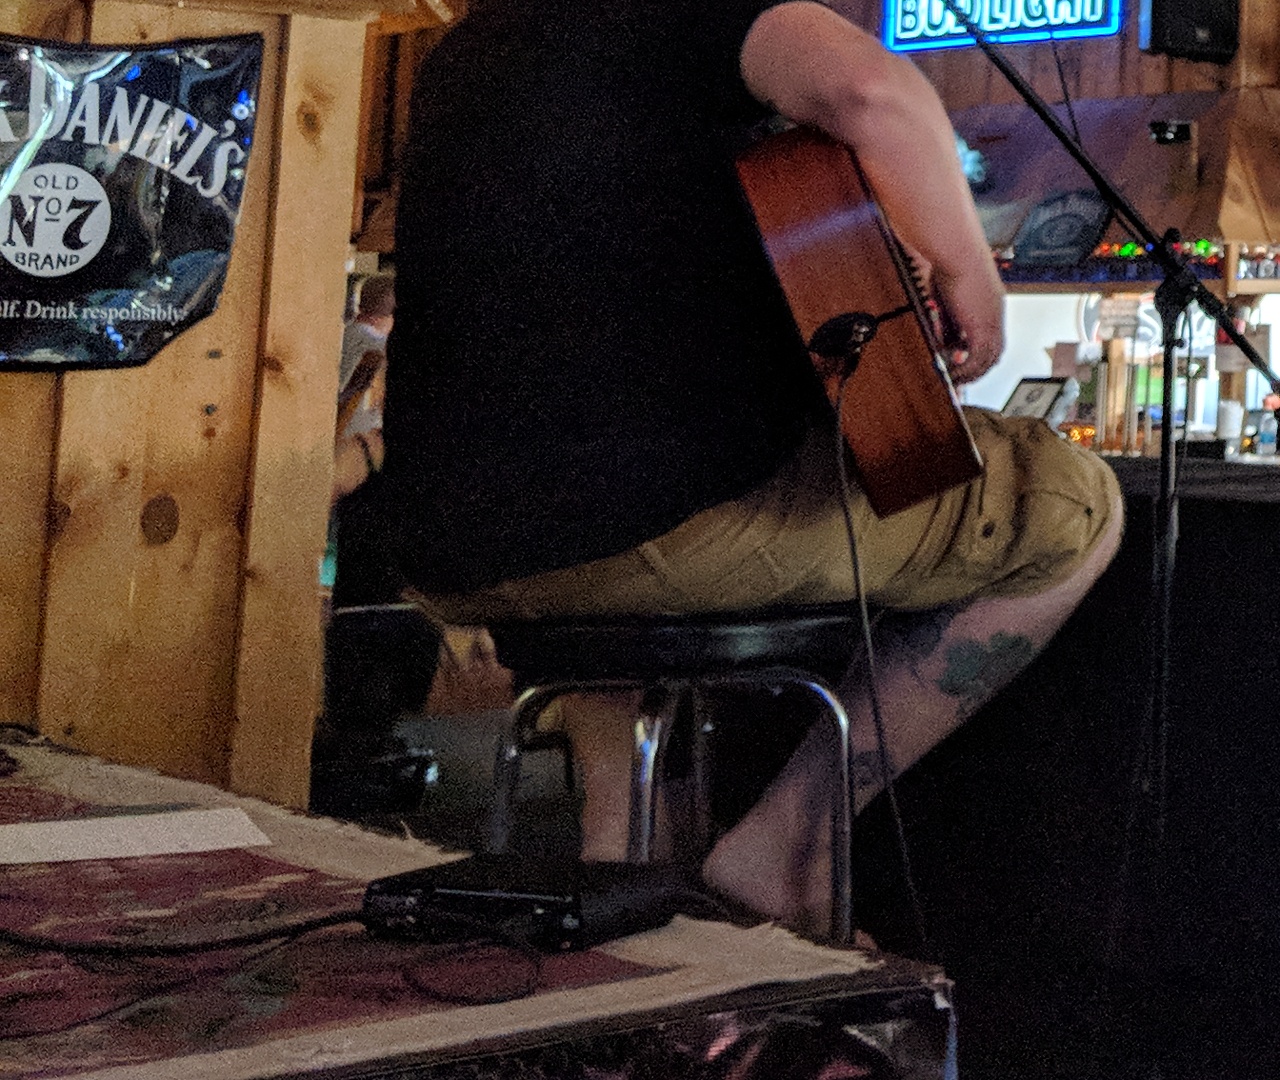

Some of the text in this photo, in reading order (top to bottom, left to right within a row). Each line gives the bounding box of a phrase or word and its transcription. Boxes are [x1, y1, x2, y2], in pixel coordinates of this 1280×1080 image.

[34, 174, 79, 190] OLD
[15, 252, 80, 271] BRAND
[25, 299, 79, 319] Drink
[83, 301, 187, 326] responsibly.
